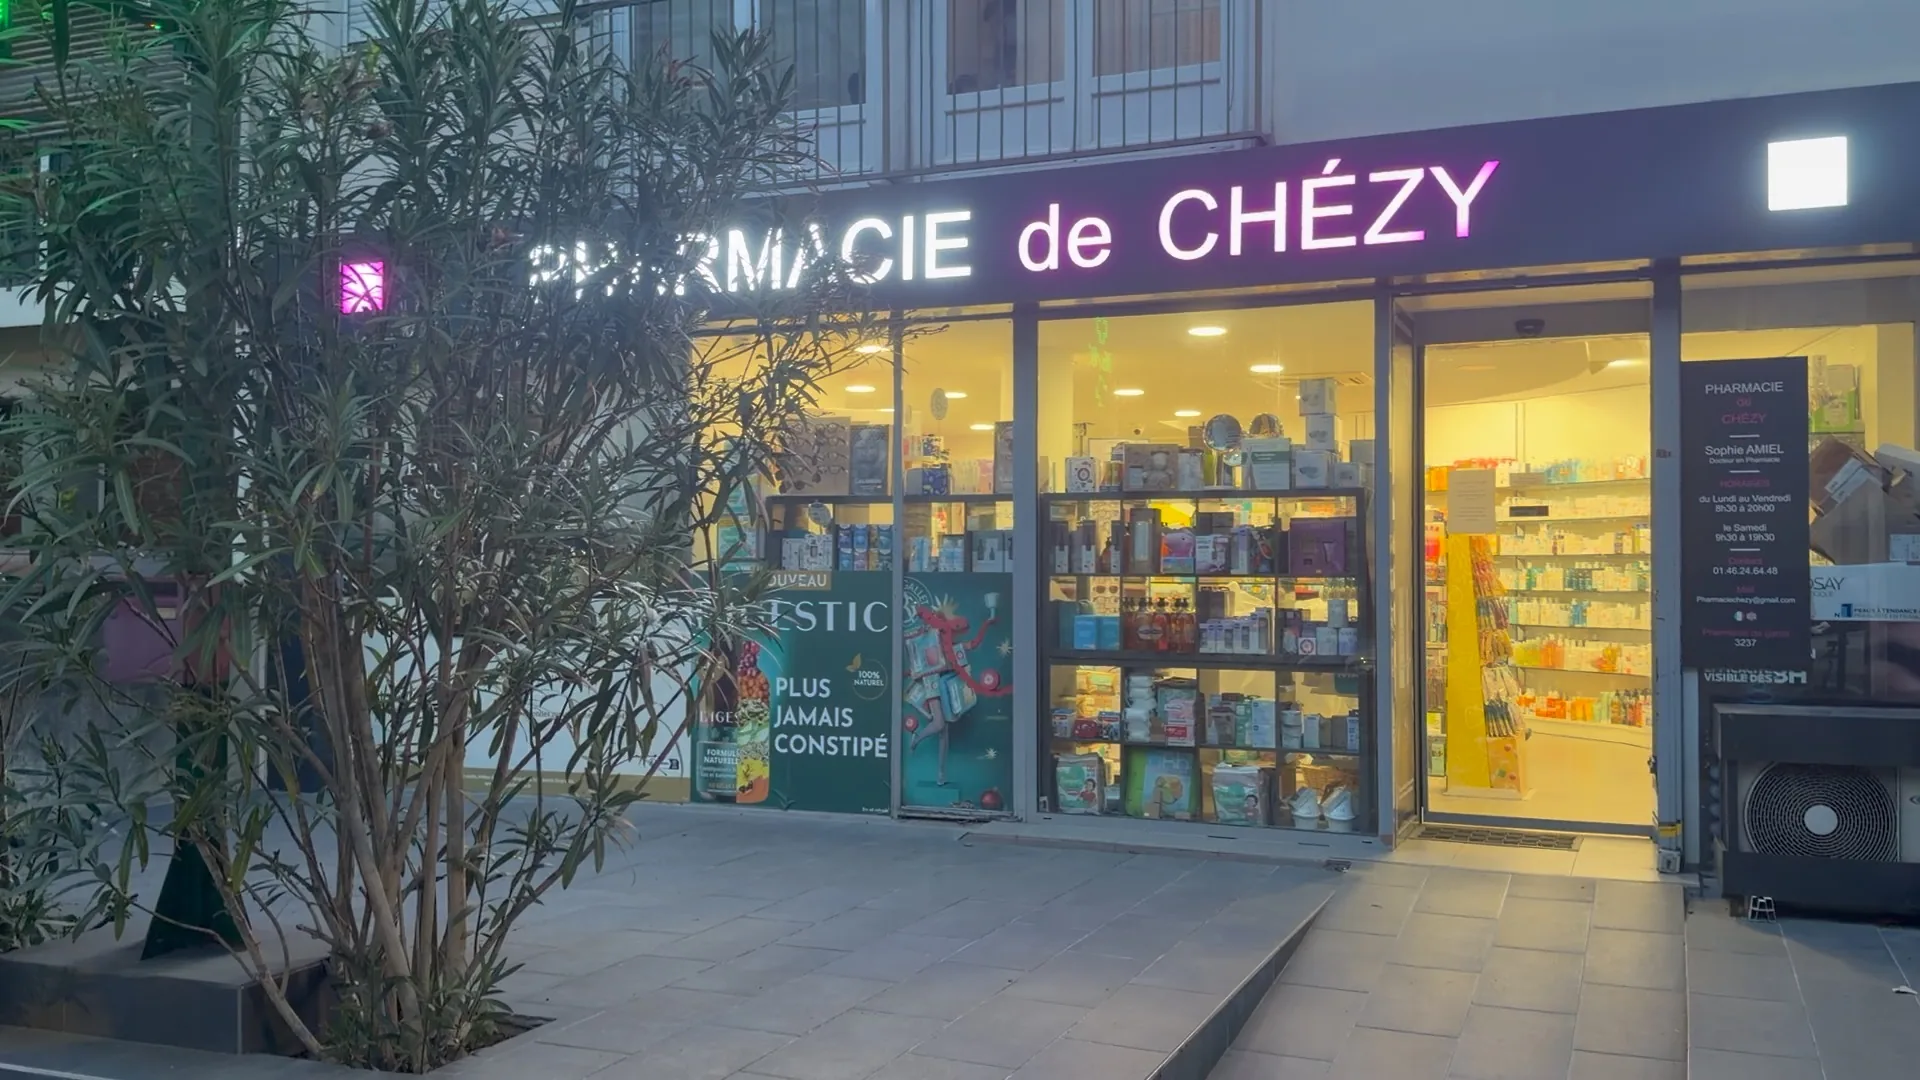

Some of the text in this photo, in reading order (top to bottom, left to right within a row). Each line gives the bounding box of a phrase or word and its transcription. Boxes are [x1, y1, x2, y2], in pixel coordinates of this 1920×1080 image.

[529, 158, 1500, 304] PHRMACIE de CHÉZY
[1704, 381, 1784, 394] PHARMACIE
[1704, 444, 1785, 457] Sophie AMIEL
[1699, 494, 1791, 503] du Lundi au Vendredi
[1715, 503, 1775, 513] 8h30 à 20h00
[1722, 523, 1767, 532] le Samedi
[1715, 533, 1776, 542] 9h30 à 19h30
[1712, 566, 1779, 576] 01.46.24.64.48
[767, 574, 827, 587] OUVEAU
[1734, 638, 1757, 647] 3237
[857, 670, 881, 680] 100%
[1704, 672, 1749, 683] VISIBLE
[775, 677, 831, 698] PLUS
[854, 678, 885, 687] NATUREL
[773, 704, 854, 728] JAMAIS
[774, 732, 888, 758] CONSTIPÉ
